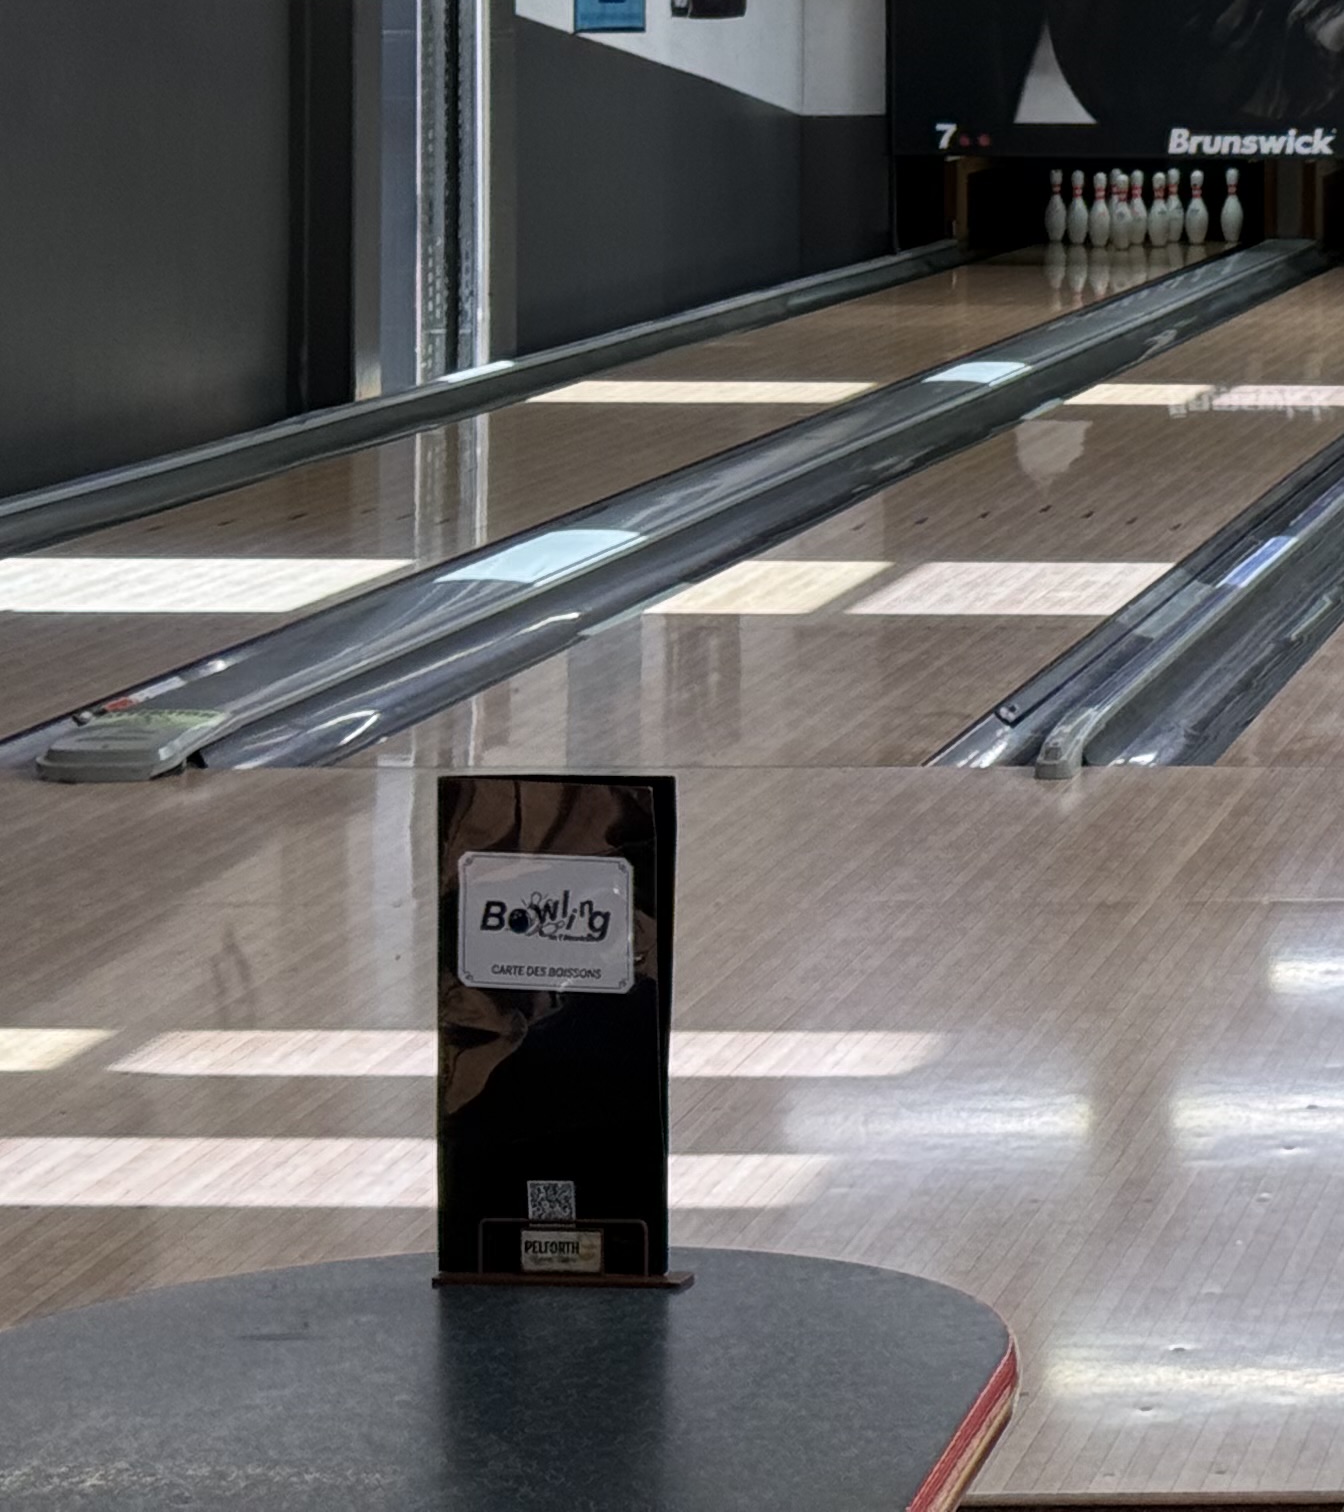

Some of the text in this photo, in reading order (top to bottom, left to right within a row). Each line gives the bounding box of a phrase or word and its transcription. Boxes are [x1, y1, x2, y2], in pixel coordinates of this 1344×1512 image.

[935, 123, 957, 149] 7
[1168, 128, 1336, 155] Brunswick
[480, 889, 611, 942] Bowling
[491, 963, 602, 980] CARTE DES BOISSONS
[524, 1239, 580, 1255] PELFORTH
